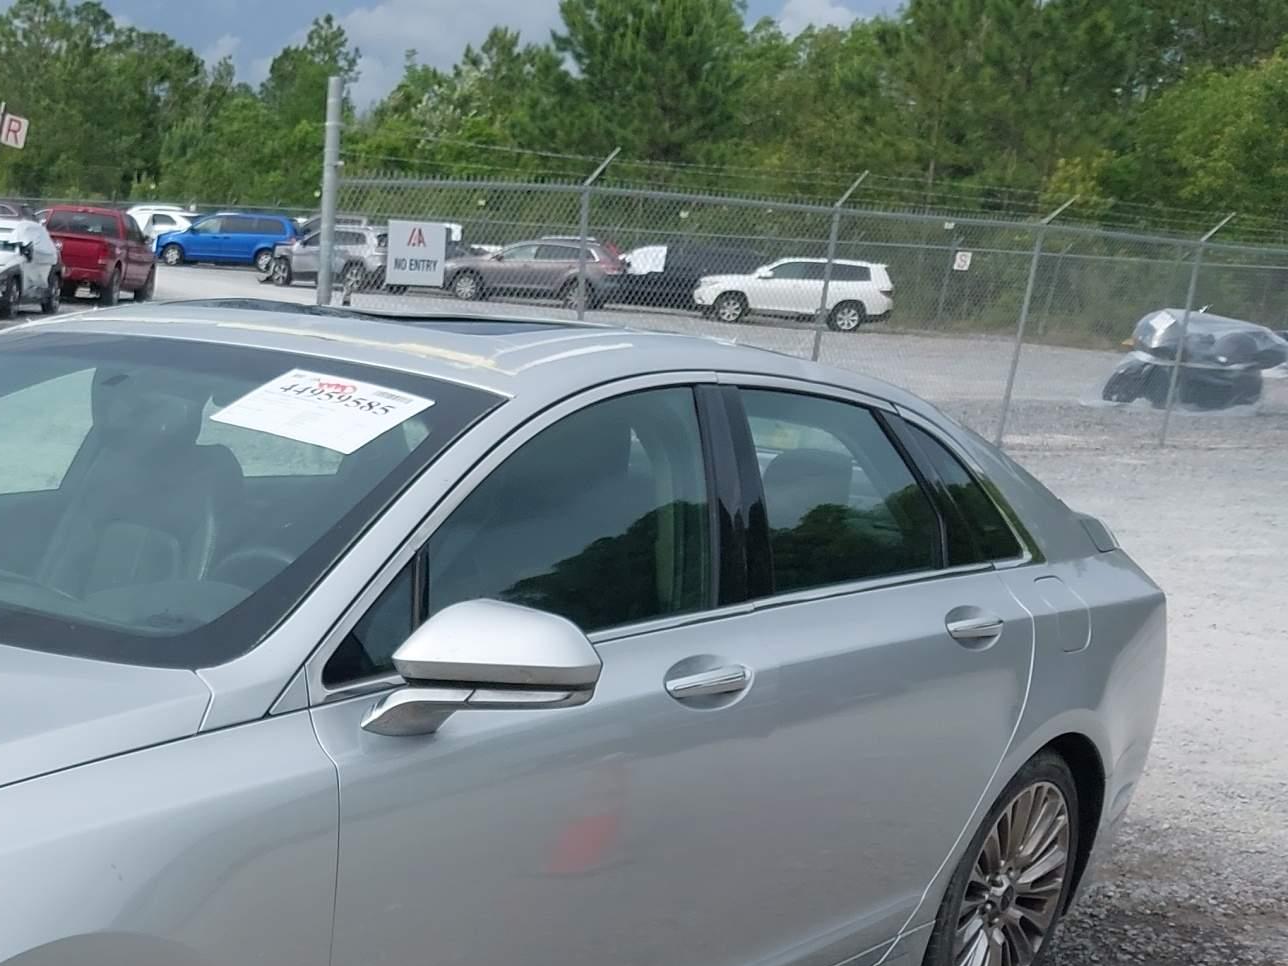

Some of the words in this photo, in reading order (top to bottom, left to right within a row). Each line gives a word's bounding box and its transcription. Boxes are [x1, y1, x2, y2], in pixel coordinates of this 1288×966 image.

[6, 118, 22, 144] R
[393, 258, 407, 271] NO
[409, 259, 438, 272] ENTRY
[279, 383, 395, 416] 44959585
